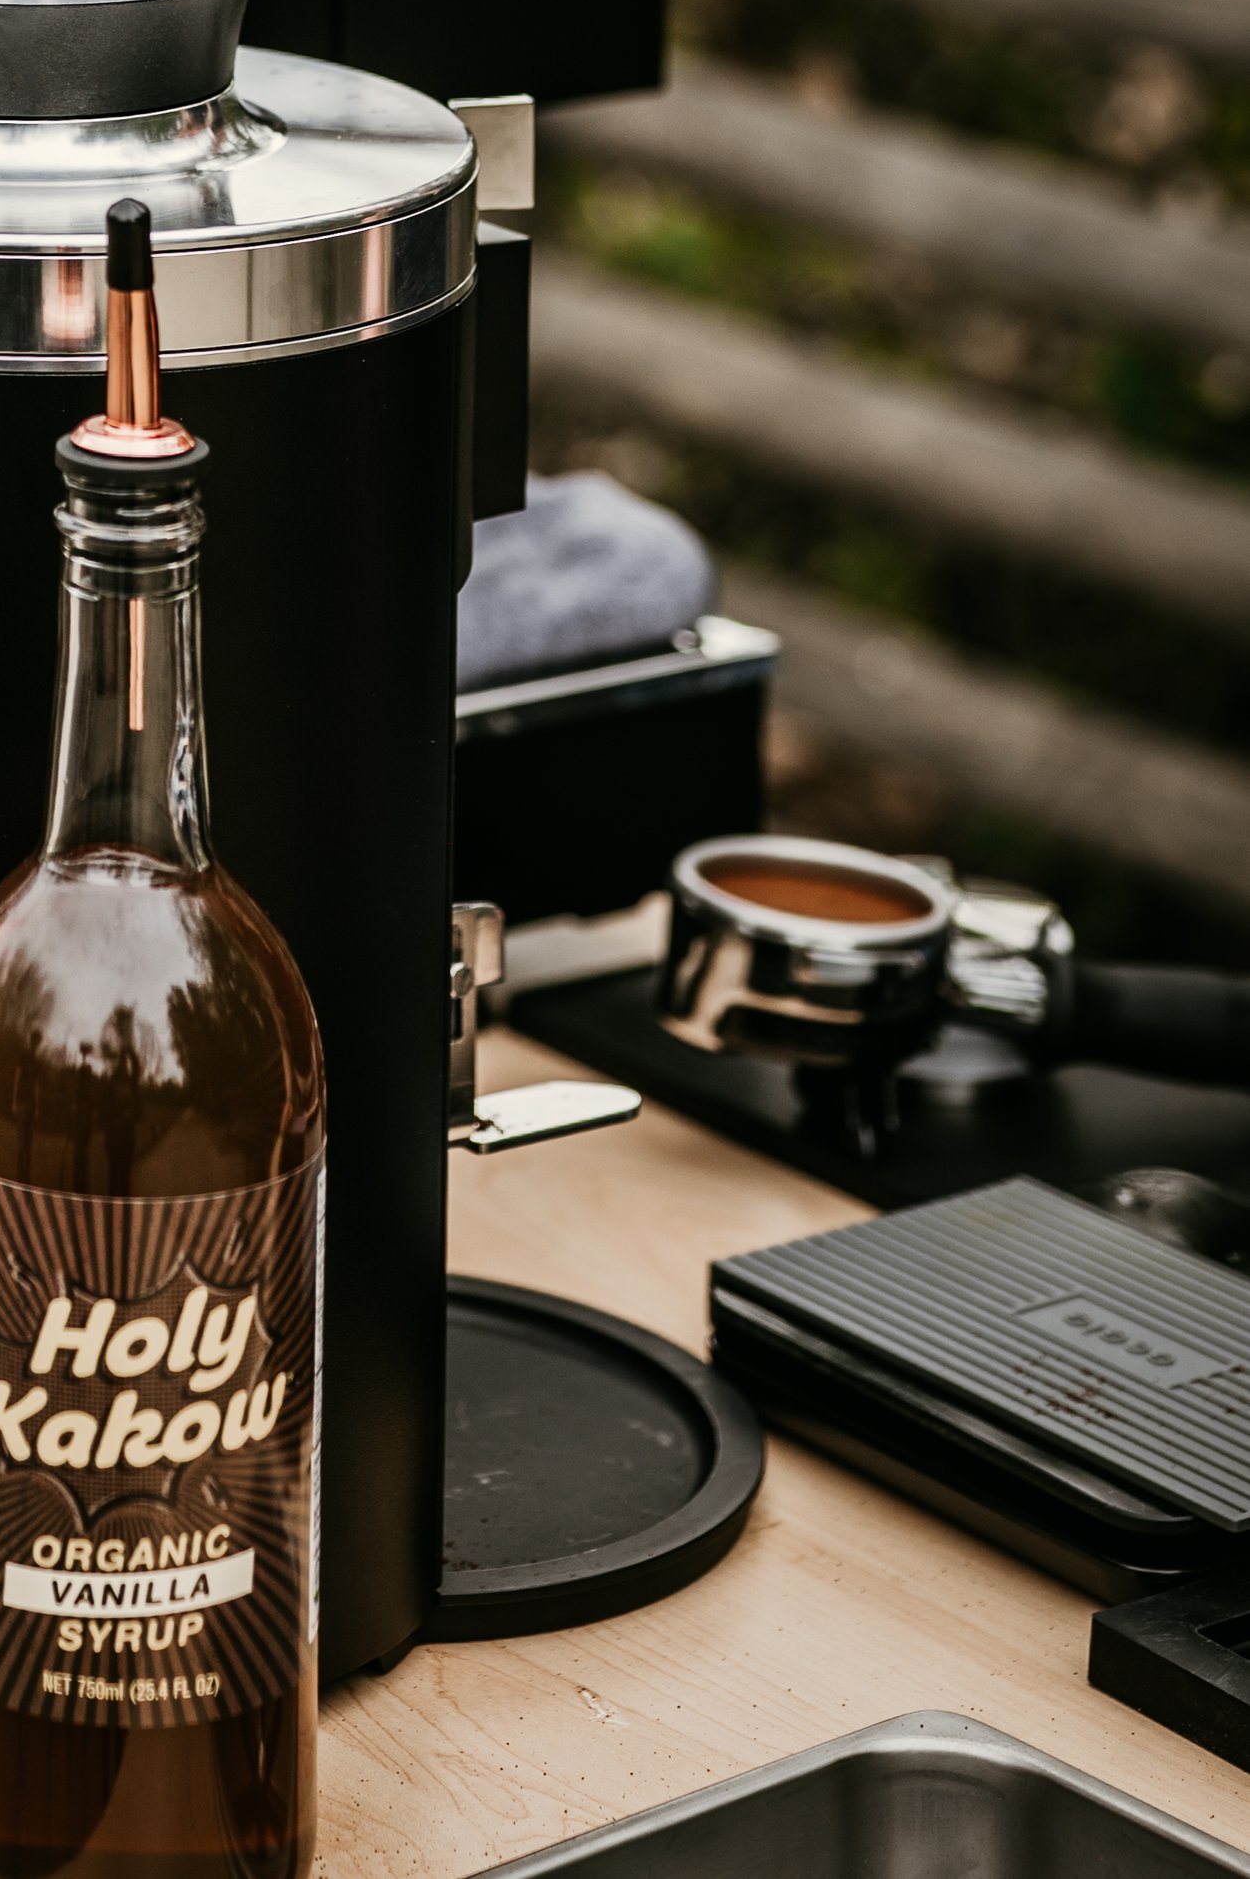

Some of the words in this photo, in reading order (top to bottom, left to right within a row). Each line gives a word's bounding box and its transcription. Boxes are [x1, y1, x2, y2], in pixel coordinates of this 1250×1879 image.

[29, 1285, 257, 1393] Holy
[31, 1522, 232, 1573] ORGANIC
[51, 1572, 211, 1609] VANILLA
[57, 1611, 205, 1655] SYRUP
[42, 1669, 72, 1697] NET
[76, 1674, 125, 1702] 750ml
[128, 1676, 170, 1705] (25.4
[172, 1674, 192, 1700] FL
[194, 1671, 222, 1698] OZ)
